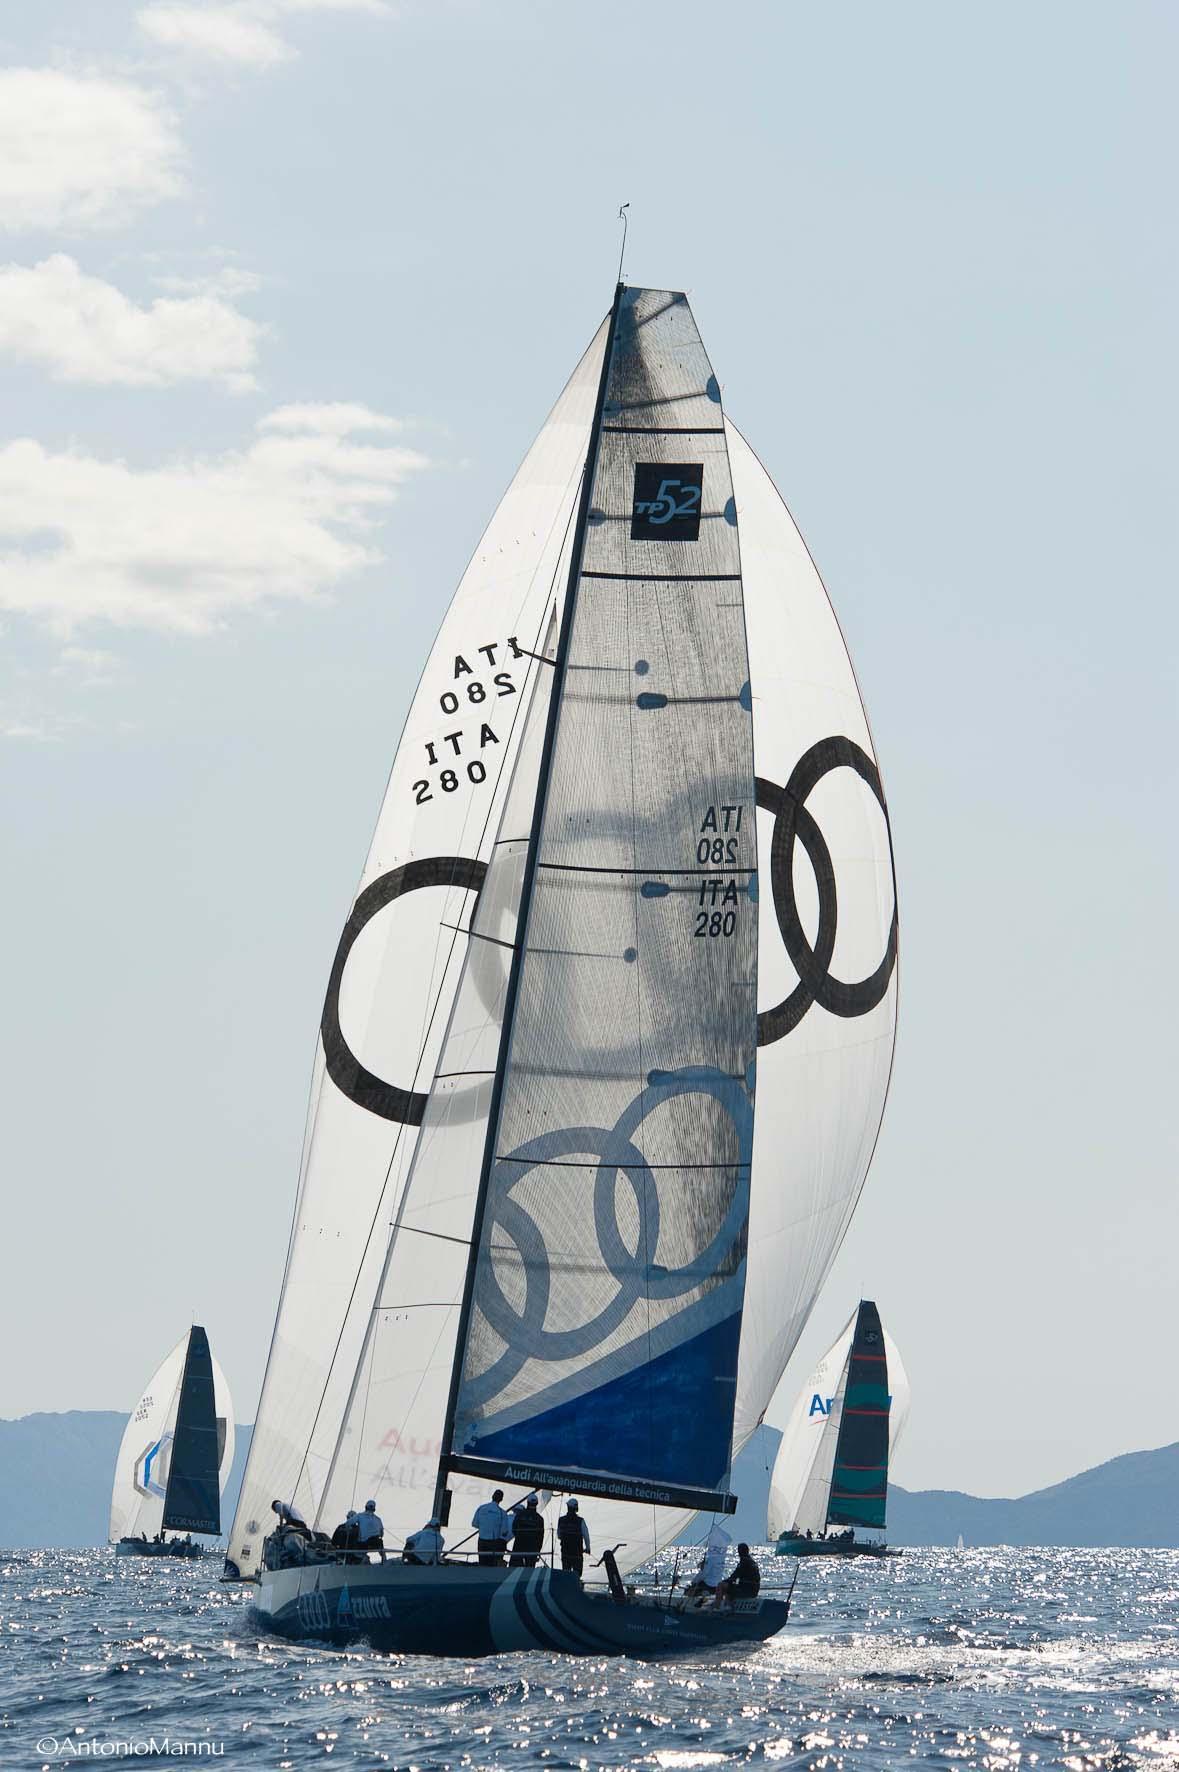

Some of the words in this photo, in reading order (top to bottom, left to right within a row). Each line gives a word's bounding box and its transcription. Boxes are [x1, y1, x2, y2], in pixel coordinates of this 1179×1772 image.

[634, 479, 701, 524] TP52
[424, 723, 500, 766] ITA
[412, 760, 487, 805] 280
[698, 879, 739, 906] ITA
[694, 911, 737, 938] 280
[378, 1428, 441, 1456] Au
[504, 1466, 532, 1481] Audi
[533, 1471, 606, 1492] All'avanguardia
[608, 1482, 633, 1497] della
[634, 1487, 671, 1502] tecnica
